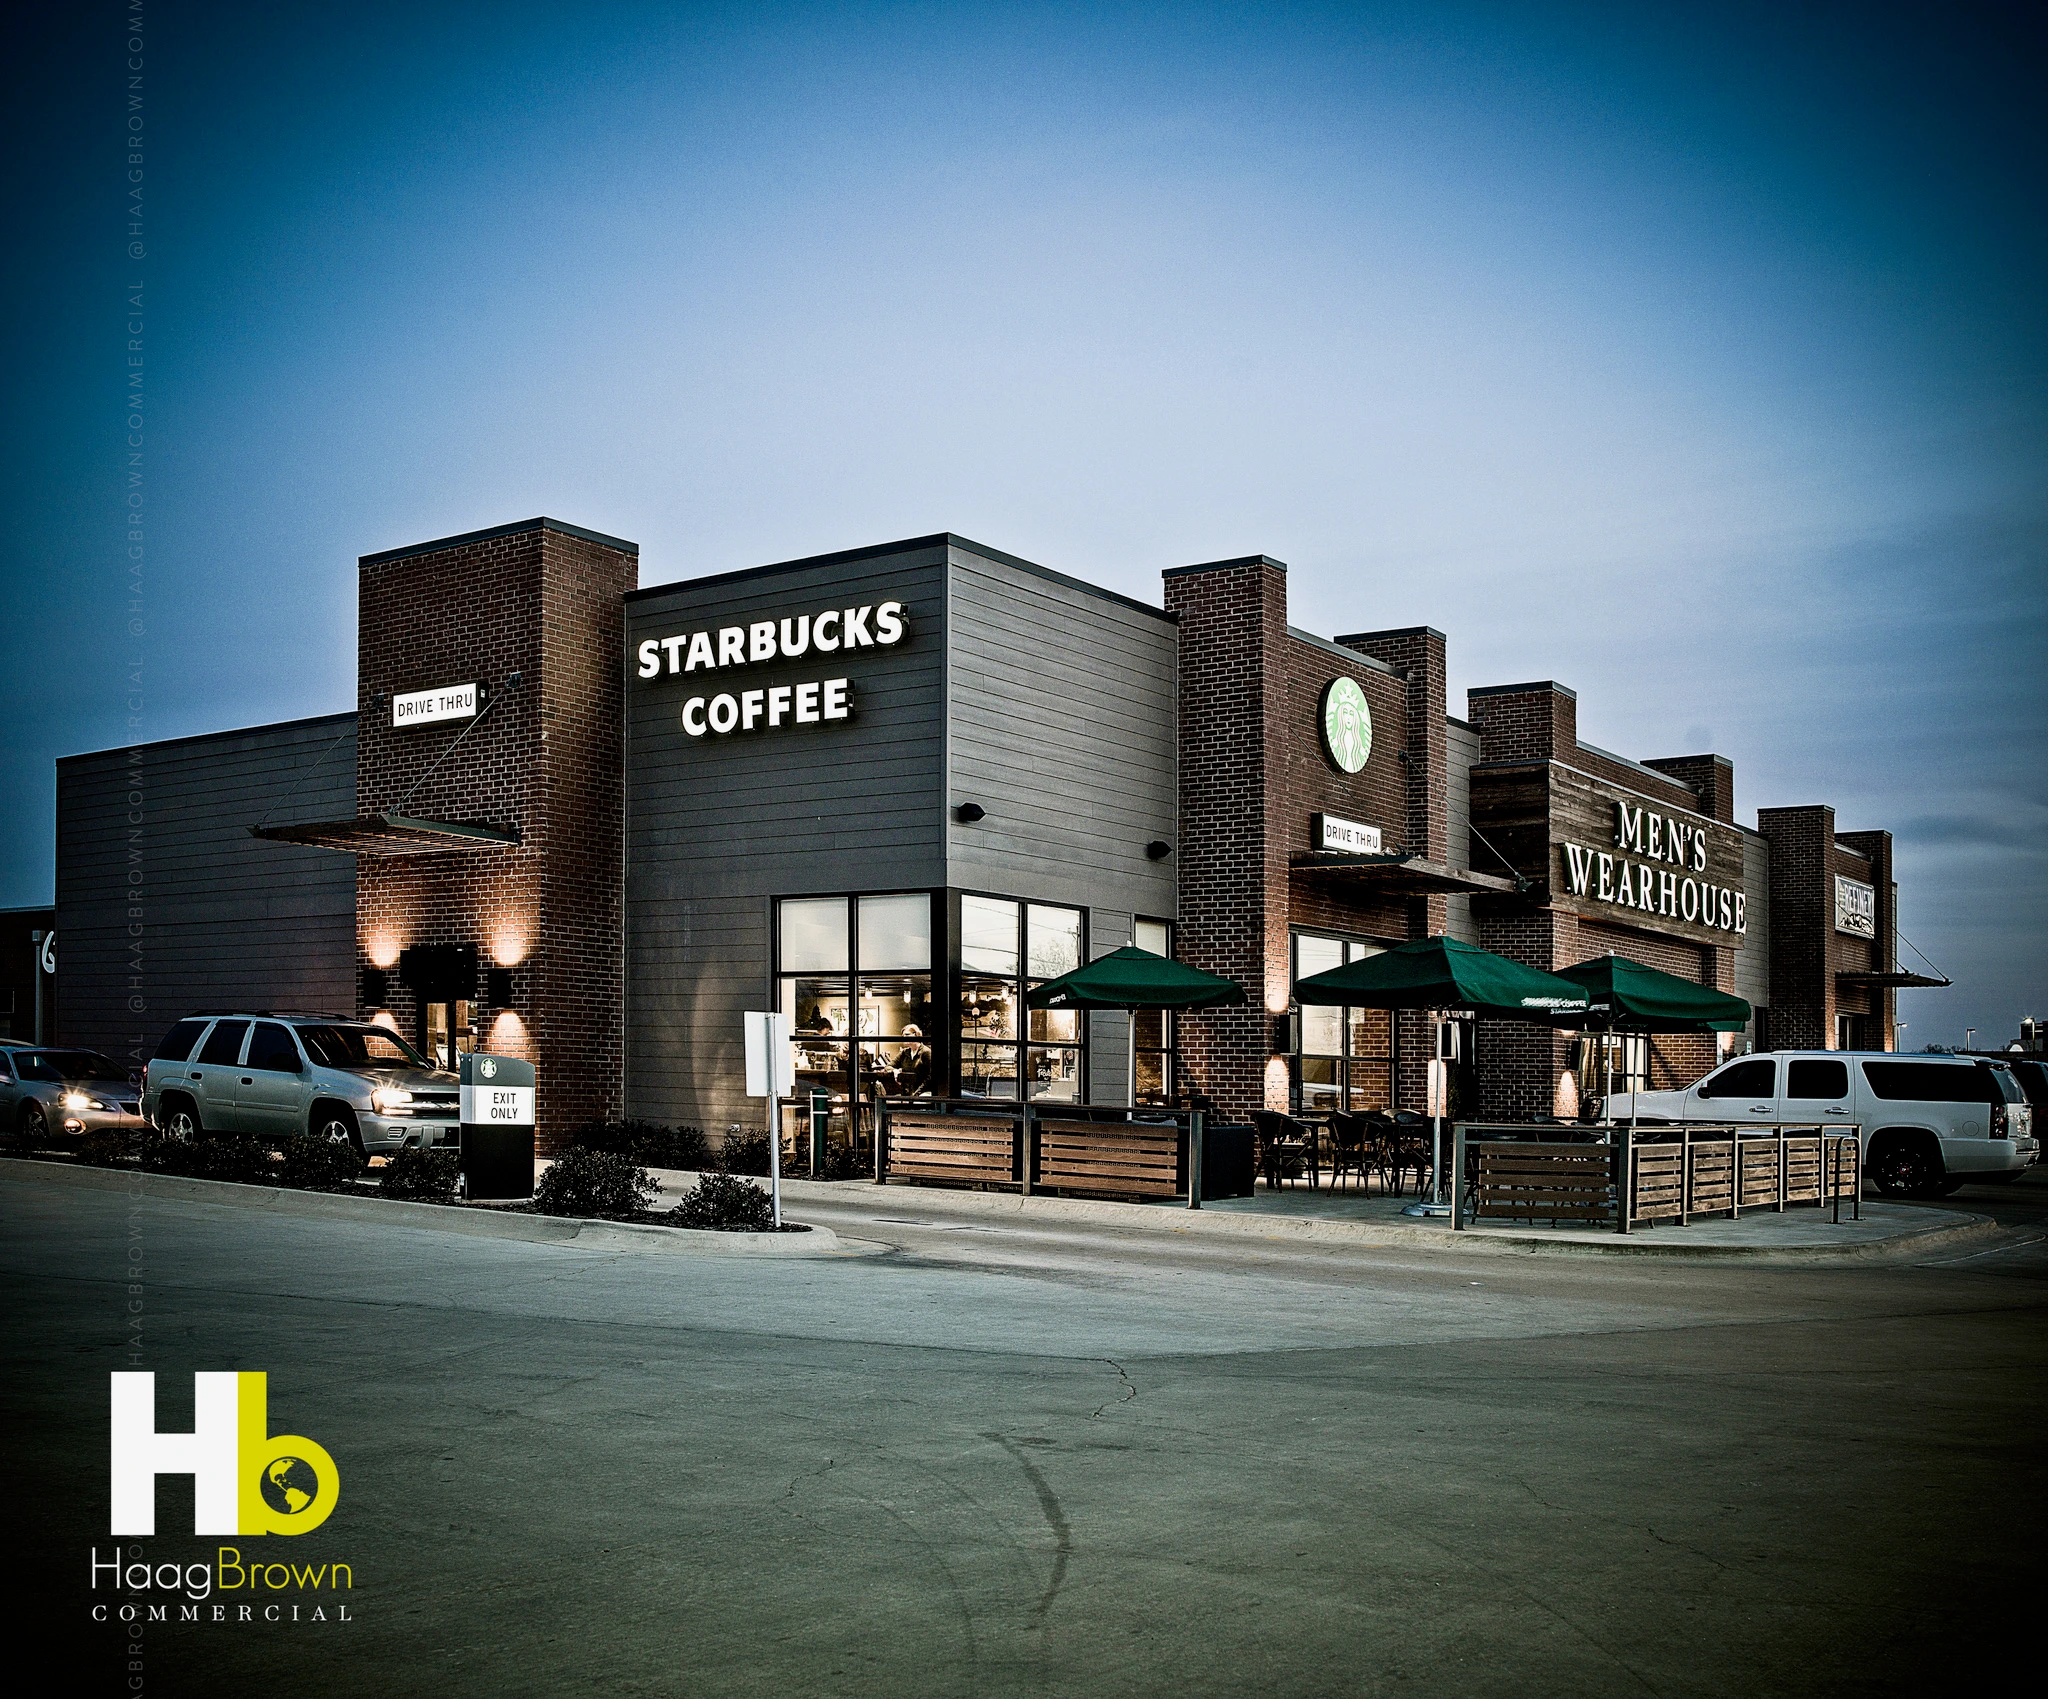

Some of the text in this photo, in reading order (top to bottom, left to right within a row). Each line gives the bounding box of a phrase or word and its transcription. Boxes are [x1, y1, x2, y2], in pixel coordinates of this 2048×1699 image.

[638, 601, 902, 678] STARBUCKS
[398, 693, 473, 717] DRIVE THRU
[681, 678, 848, 736] COFFEE
[1326, 824, 1378, 849] DRIVE THRU
[1617, 801, 1707, 872] MEN'S
[1563, 842, 1747, 935] WEARHOUSE
[490, 1107, 519, 1119] ONLY
[493, 1092, 517, 1105] EXIT
